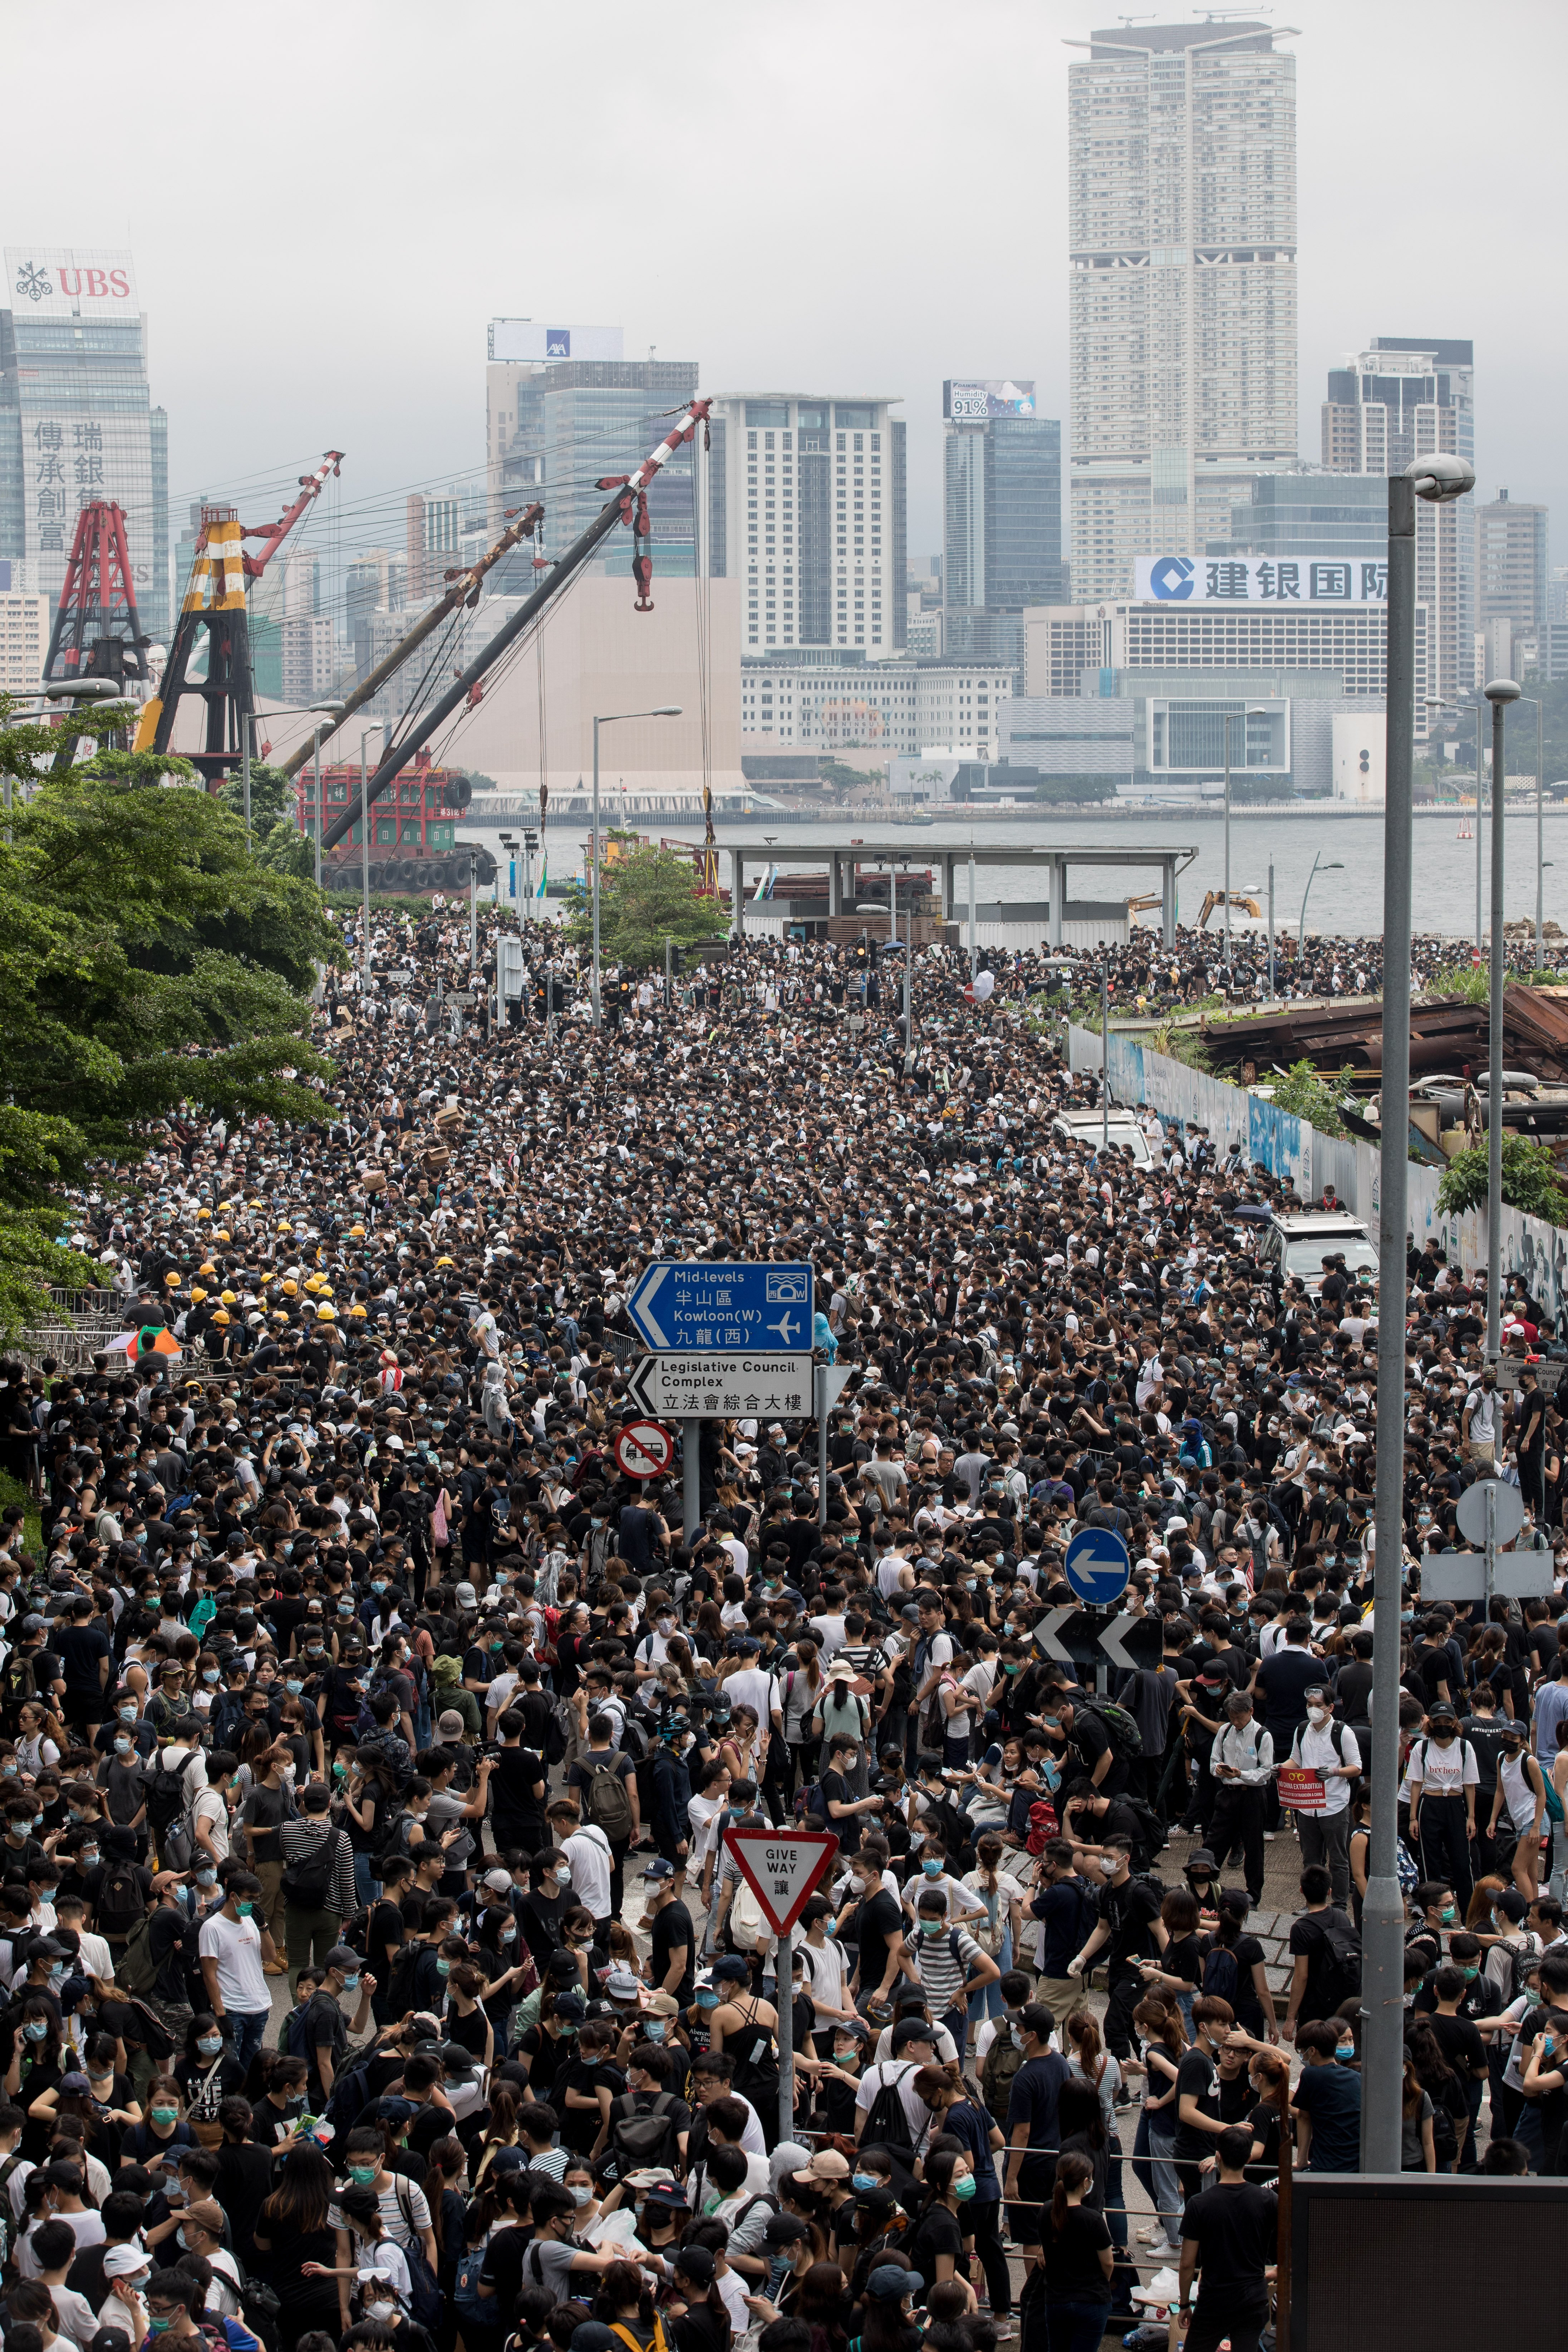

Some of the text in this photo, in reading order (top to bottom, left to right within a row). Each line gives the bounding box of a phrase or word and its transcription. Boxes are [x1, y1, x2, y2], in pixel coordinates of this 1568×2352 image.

[56, 269, 130, 298] UBS
[547, 344, 566, 355] AXA
[954, 390, 987, 399] Humidity
[954, 401, 987, 414] 91%
[34, 421, 66, 551] 傳承創富
[675, 1271, 744, 1283] Mid-levels
[675, 1290, 732, 1306] 半山區
[796, 1290, 805, 1298] W
[674, 1310, 762, 1323] Kowloon(W)
[676, 1328, 749, 1344] 九龍(西)
[662, 1361, 795, 1373] Legislative Council
[1538, 1367, 1560, 1376] Council
[662, 1376, 723, 1389] Complex
[662, 1394, 802, 1411] 立法會綜合大樓
[1430, 1766, 1460, 1774] brohers
[766, 1849, 797, 1860] GIVE
[767, 1863, 796, 1874] WAY
[774, 1880, 790, 1895] 讓
[689, 2028, 711, 2036] Abercro
